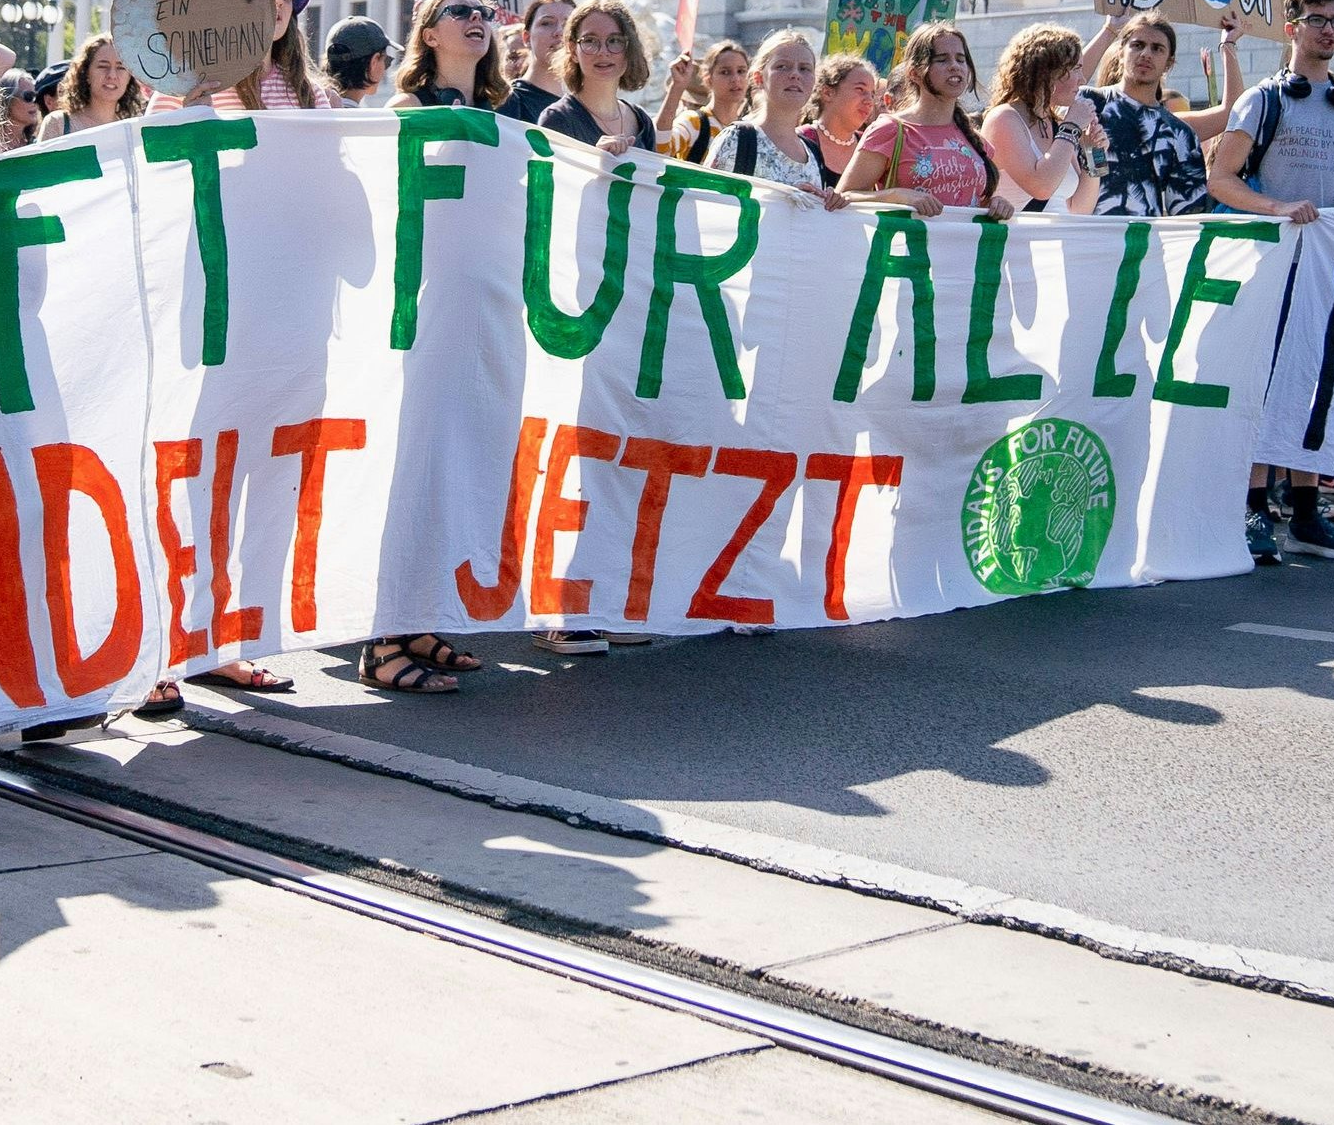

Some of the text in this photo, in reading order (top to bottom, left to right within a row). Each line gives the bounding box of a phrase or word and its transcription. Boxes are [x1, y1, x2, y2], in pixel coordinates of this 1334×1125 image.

[828, 20, 910, 74] WOR
[871, 11, 907, 32] THE
[137, 21, 265, 80] SCHNEEMANN
[932, 156, 966, 180] Hello
[1289, 137, 1319, 148] BACKED
[1321, 140, 1331, 150] BY
[389, 105, 762, 401] FÜR
[832, 208, 1282, 409] ALLE
[455, 416, 903, 625] JETZT
[966, 423, 1109, 583] FRIDAYS FOR FUTURE
